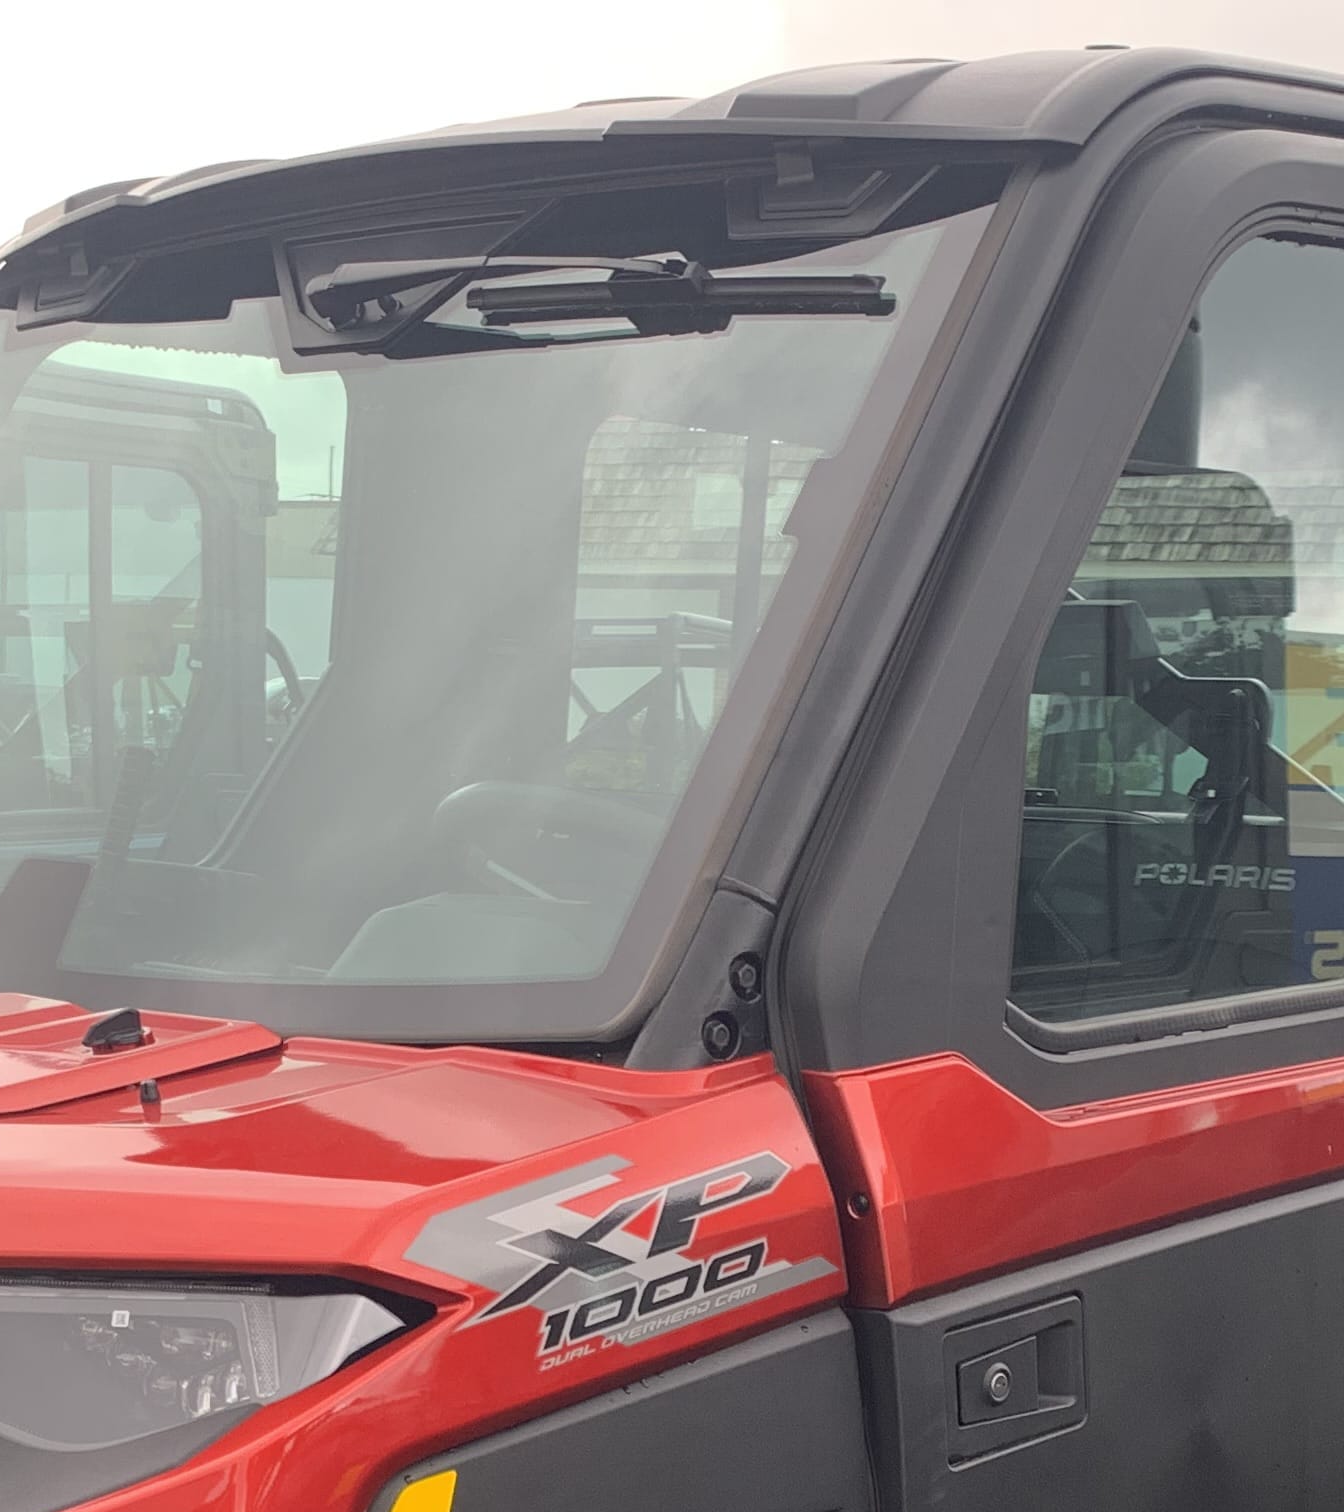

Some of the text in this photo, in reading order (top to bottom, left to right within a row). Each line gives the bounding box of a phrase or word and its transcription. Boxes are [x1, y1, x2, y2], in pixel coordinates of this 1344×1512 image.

[1133, 862, 1296, 892] POLARIS
[466, 1150, 791, 1323] XP
[539, 1239, 767, 1354] 1000
[539, 1283, 758, 1372] DUAL OVERHEAD CAM
